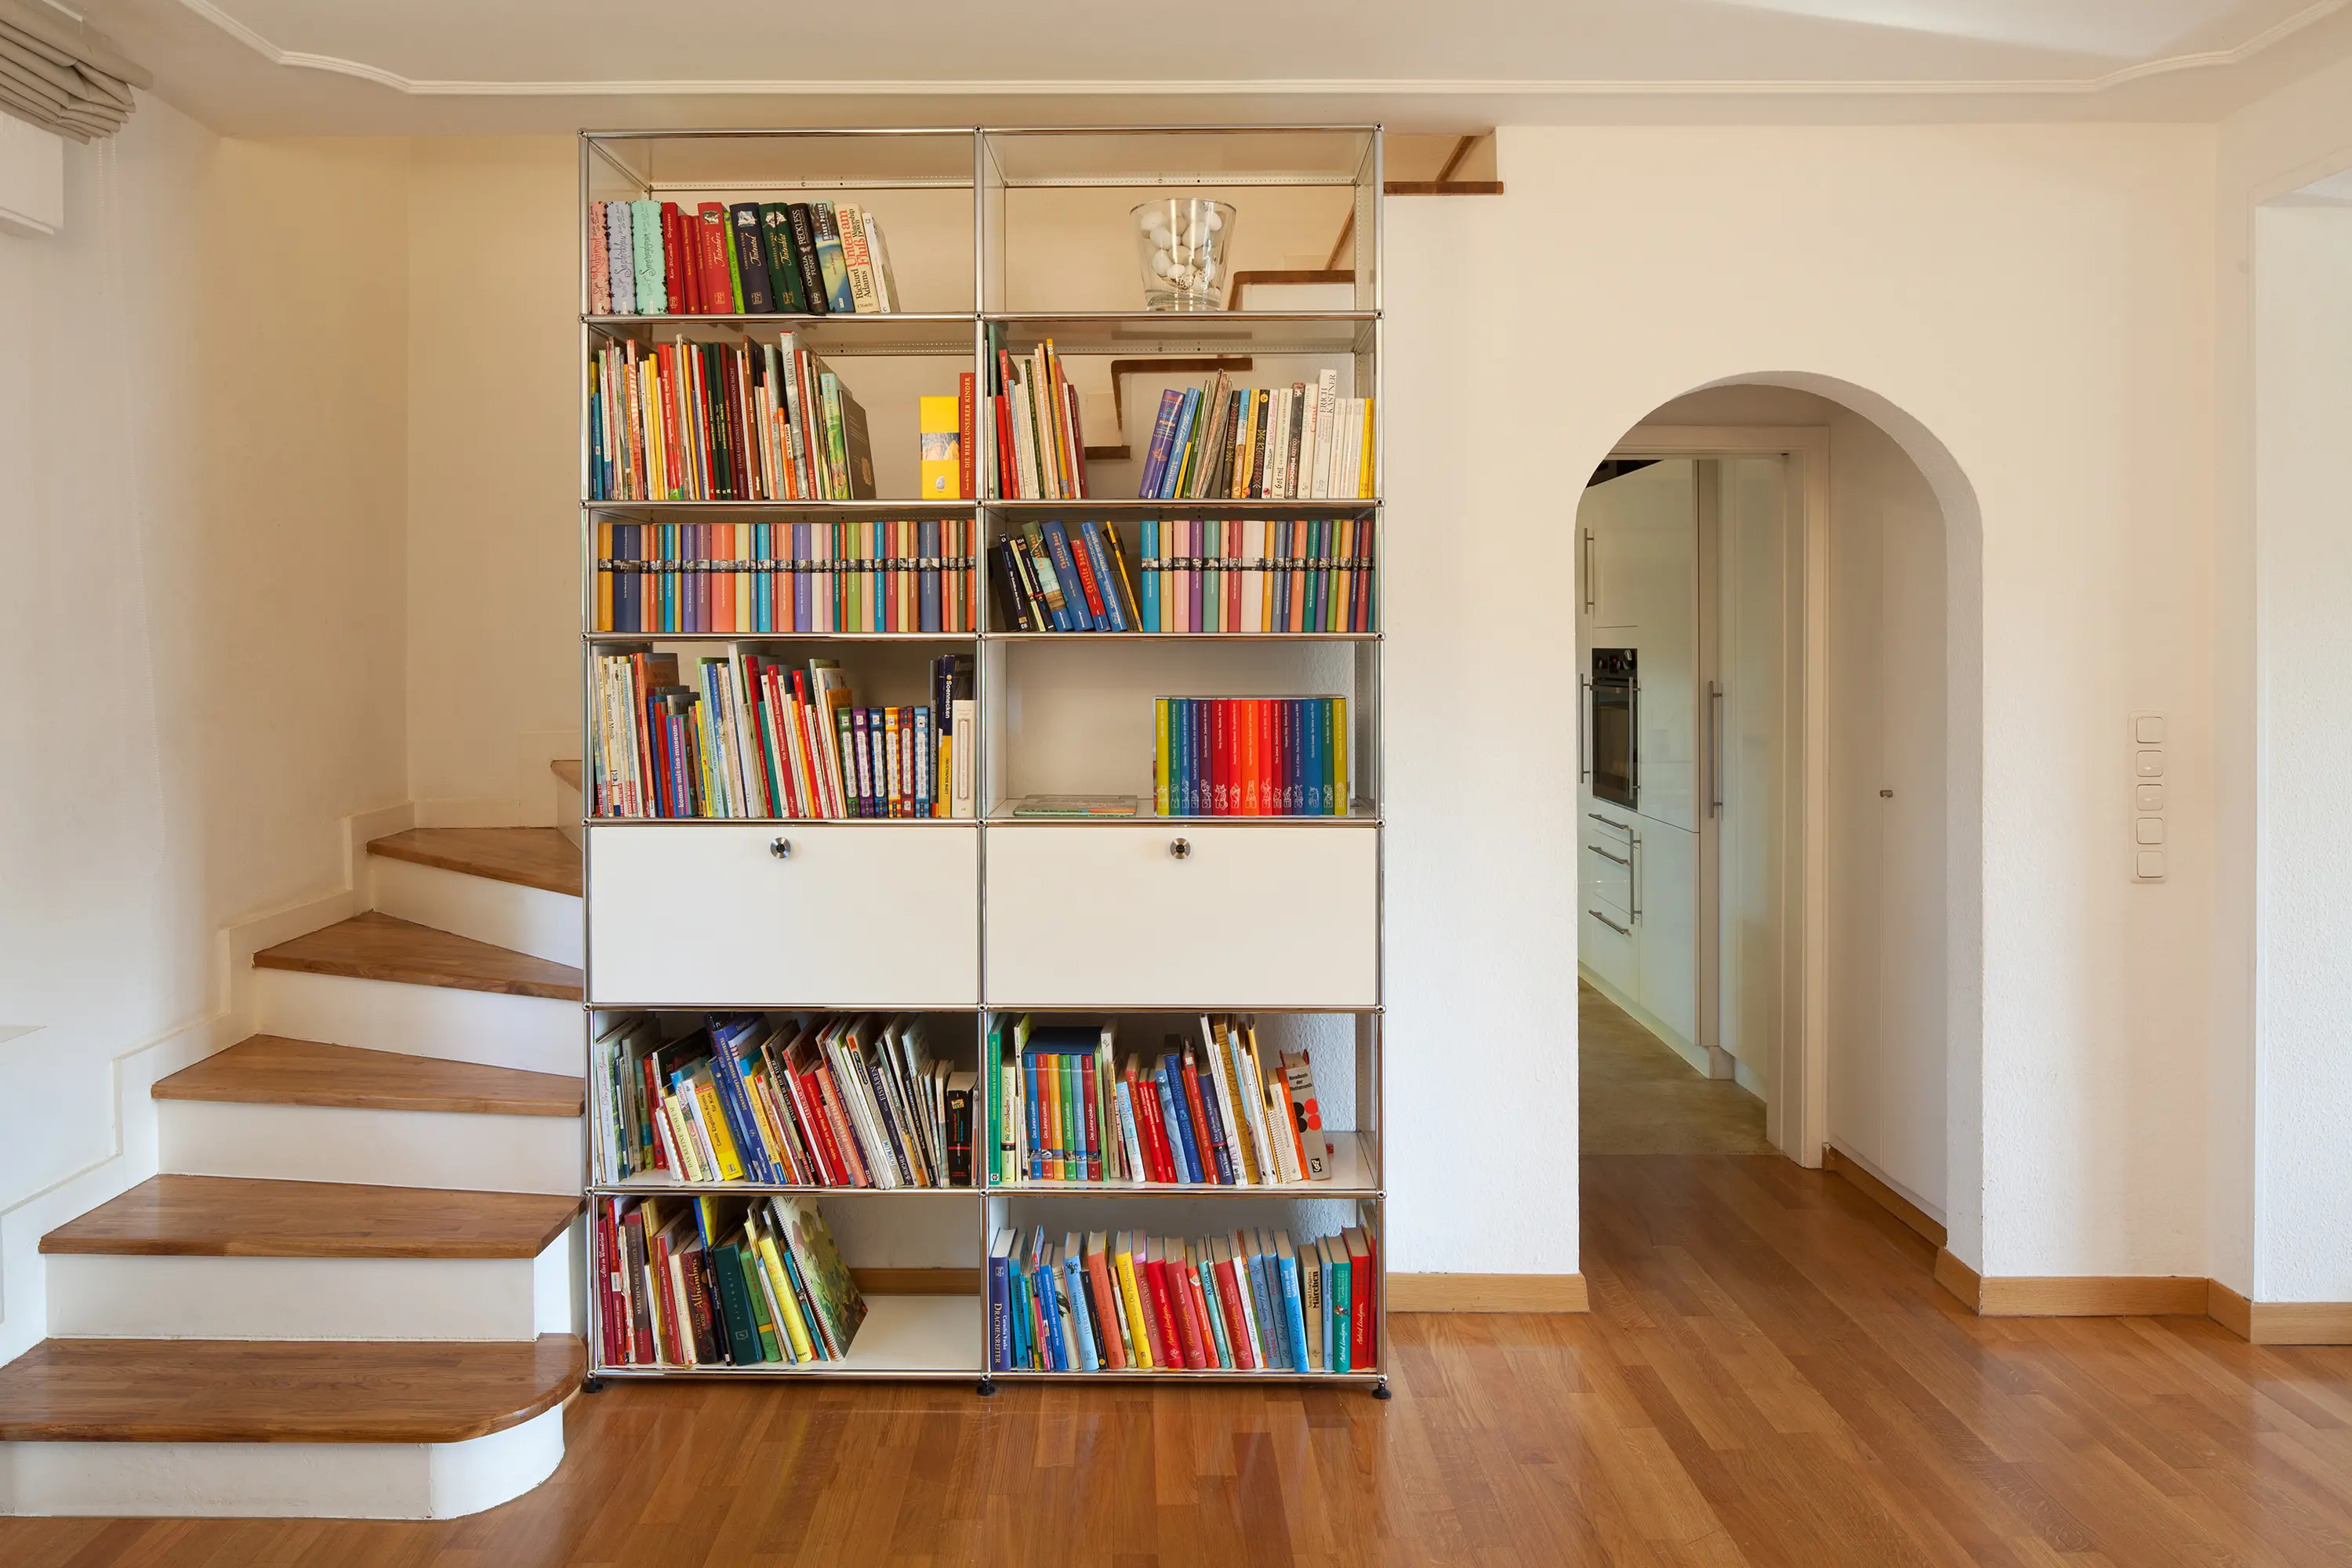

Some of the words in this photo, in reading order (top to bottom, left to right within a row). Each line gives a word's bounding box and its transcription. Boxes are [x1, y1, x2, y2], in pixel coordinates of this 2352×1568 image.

[817, 205, 827, 223] POTTER
[838, 210, 850, 230] am
[848, 209, 858, 238] Watership
[793, 209, 808, 245] RECKLESS
[819, 224, 830, 240] HARRY
[855, 220, 865, 237] Down
[711, 232, 725, 267] Tintenherz
[843, 231, 858, 267] Unten
[854, 238, 870, 266] Fluß
[802, 256, 813, 286] CORNELIA
[808, 254, 818, 276] FUNKE
[851, 269, 864, 299] Richard
[861, 270, 872, 298] Adams
[786, 351, 794, 387] MÄRCHEN
[1319, 388, 1328, 413] ERICH
[1326, 375, 1336, 414] KÄSTNER
[1230, 403, 1240, 423] HEXE
[1308, 405, 1318, 433] Emil
[1226, 425, 1236, 448] KLEINE
[1257, 430, 1266, 441] DIE
[1225, 452, 1234, 462] DIE
[1255, 442, 1265, 465] KLEINE
[1252, 465, 1261, 484] HEXE
[1275, 466, 1283, 489] GOETHE
[1051, 532, 1061, 546] Bone
[1056, 547, 1067, 569] Charlie
[1076, 549, 1086, 565] Bone
[1081, 568, 1094, 593] Charlie
[944, 681, 953, 719] Soennecken
[672, 724, 681, 756] museum
[719, 1037, 731, 1062] TESSLOFFS
[727, 1062, 737, 1079] GROSSE
[771, 1058, 781, 1074] TIERE
[1224, 1051, 1240, 1097] ÄGYPTEN
[731, 1080, 748, 1111] LÄNDERKUNDE
[794, 1080, 803, 1091] NIL
[798, 1091, 806, 1102] AM
[870, 1066, 887, 1102] EISBÄREN
[706, 1092, 716, 1104] Kids
[781, 1086, 797, 1121] KINDERSTUBE
[802, 1102, 811, 1119] LEBEN
[822, 1079, 849, 1142] PFLANZENKUNDE
[1206, 1096, 1214, 1116] Schlüssel
[670, 1105, 682, 1133] MUSEUM
[700, 1094, 717, 1133] Englisch-Krimis
[678, 1134, 690, 1156] KLEINE
[713, 1134, 722, 1147] Coole
[684, 1156, 693, 1169] DAS
[829, 1148, 837, 1160] nichts
[883, 1142, 896, 1166] MITMACH
[1222, 1152, 1231, 1177] Hawking
[864, 1169, 874, 1183] BELTZ
[688, 1258, 703, 1308] Alhambra
[1122, 1260, 1134, 1292] Penderwicks
[726, 1272, 741, 1319] BIOLOGIE
[1076, 1279, 1085, 1299] DIEBE
[1255, 1281, 1265, 1297] Astrid
[1311, 1270, 1319, 1308] Märchen
[1163, 1304, 1174, 1329] Lindgren
[1181, 1306, 1192, 1330] Lindgren
[1258, 1298, 1268, 1323] Lindgren
[1291, 1304, 1301, 1329] Lindgren
[1356, 1302, 1365, 1327] Lindgren
[994, 1303, 1003, 1363] DRACHENREITER
[1166, 1329, 1175, 1346] Astrid
[1185, 1330, 1195, 1346] Astrid
[1263, 1330, 1272, 1359] Löwenherz
